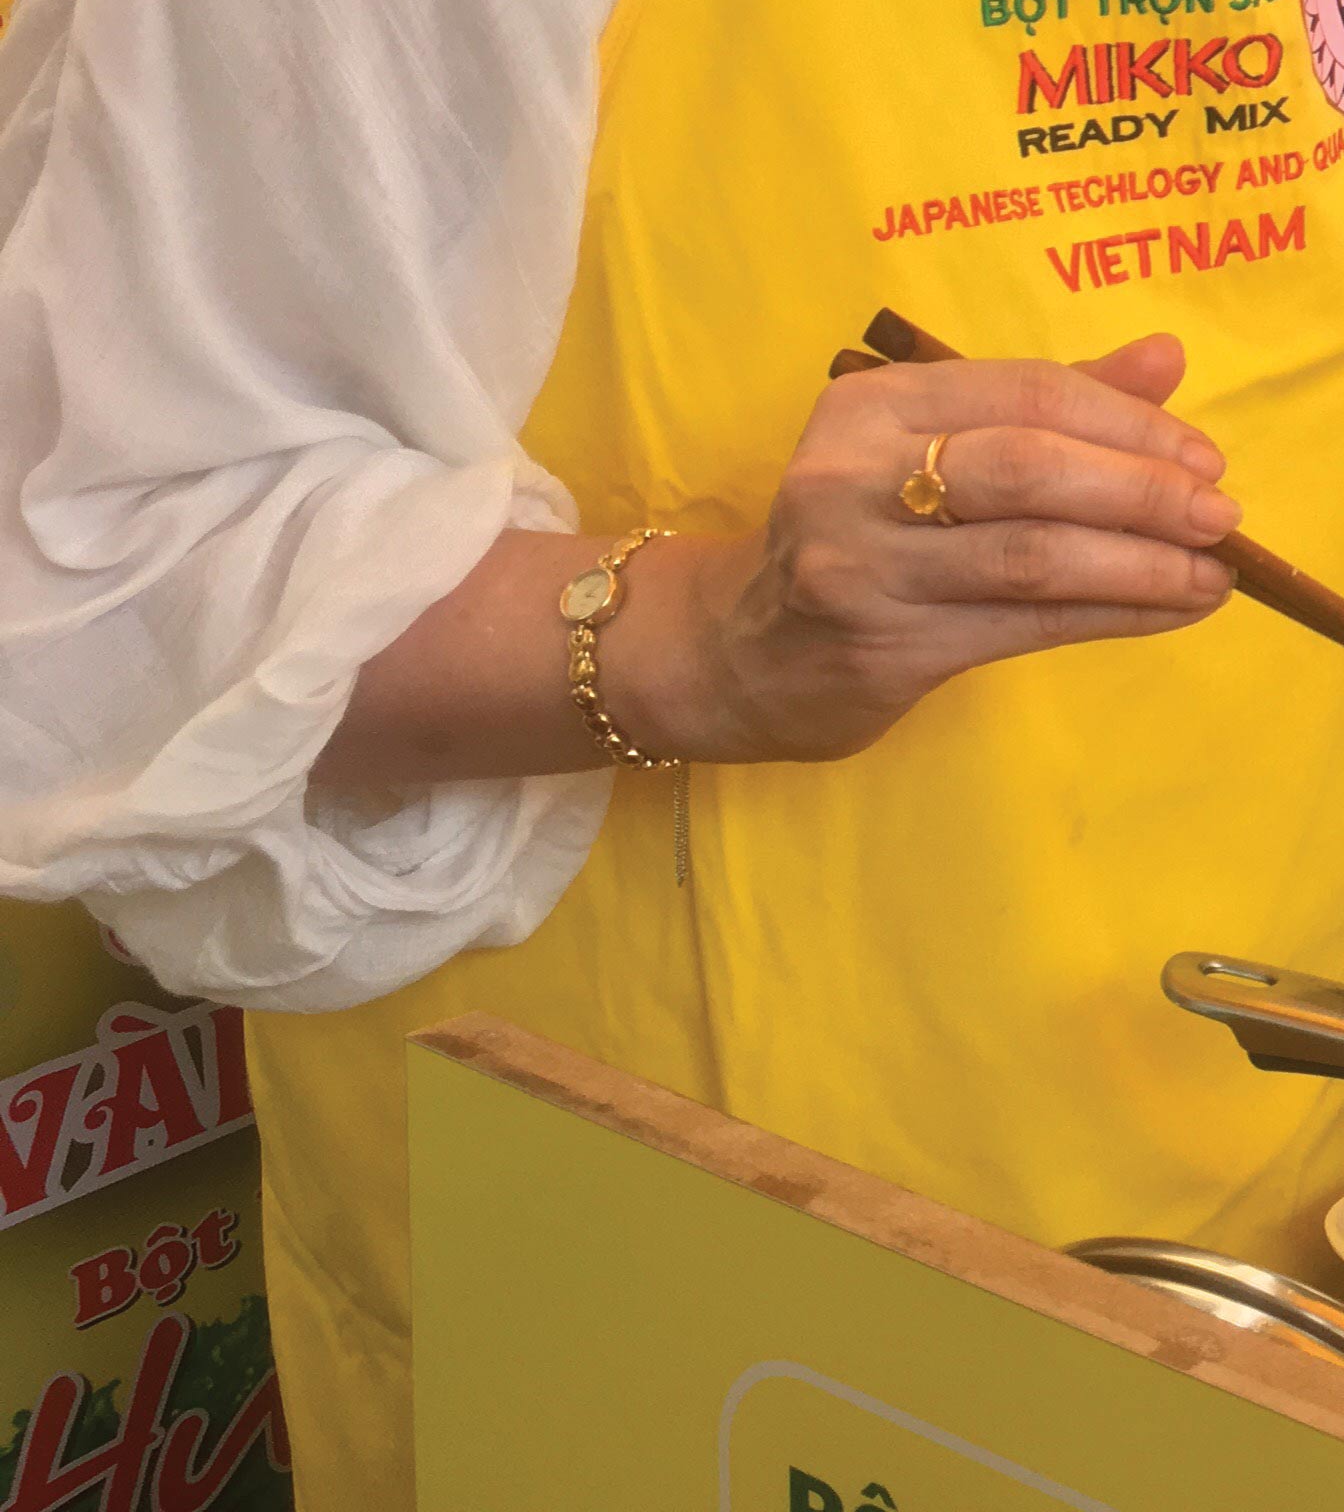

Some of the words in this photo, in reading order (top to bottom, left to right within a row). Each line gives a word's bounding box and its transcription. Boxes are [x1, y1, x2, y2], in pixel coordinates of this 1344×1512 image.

[1015, 33, 1284, 115] MIKKO
[1017, 109, 1181, 158] READY
[1205, 96, 1291, 135] MIX
[872, 185, 1044, 242] JAPANESE
[1046, 161, 1225, 215] TECHLOGY
[1235, 150, 1306, 191] AND
[1046, 205, 1307, 293] VIETNAM
[70, 1208, 243, 1329] Bột
